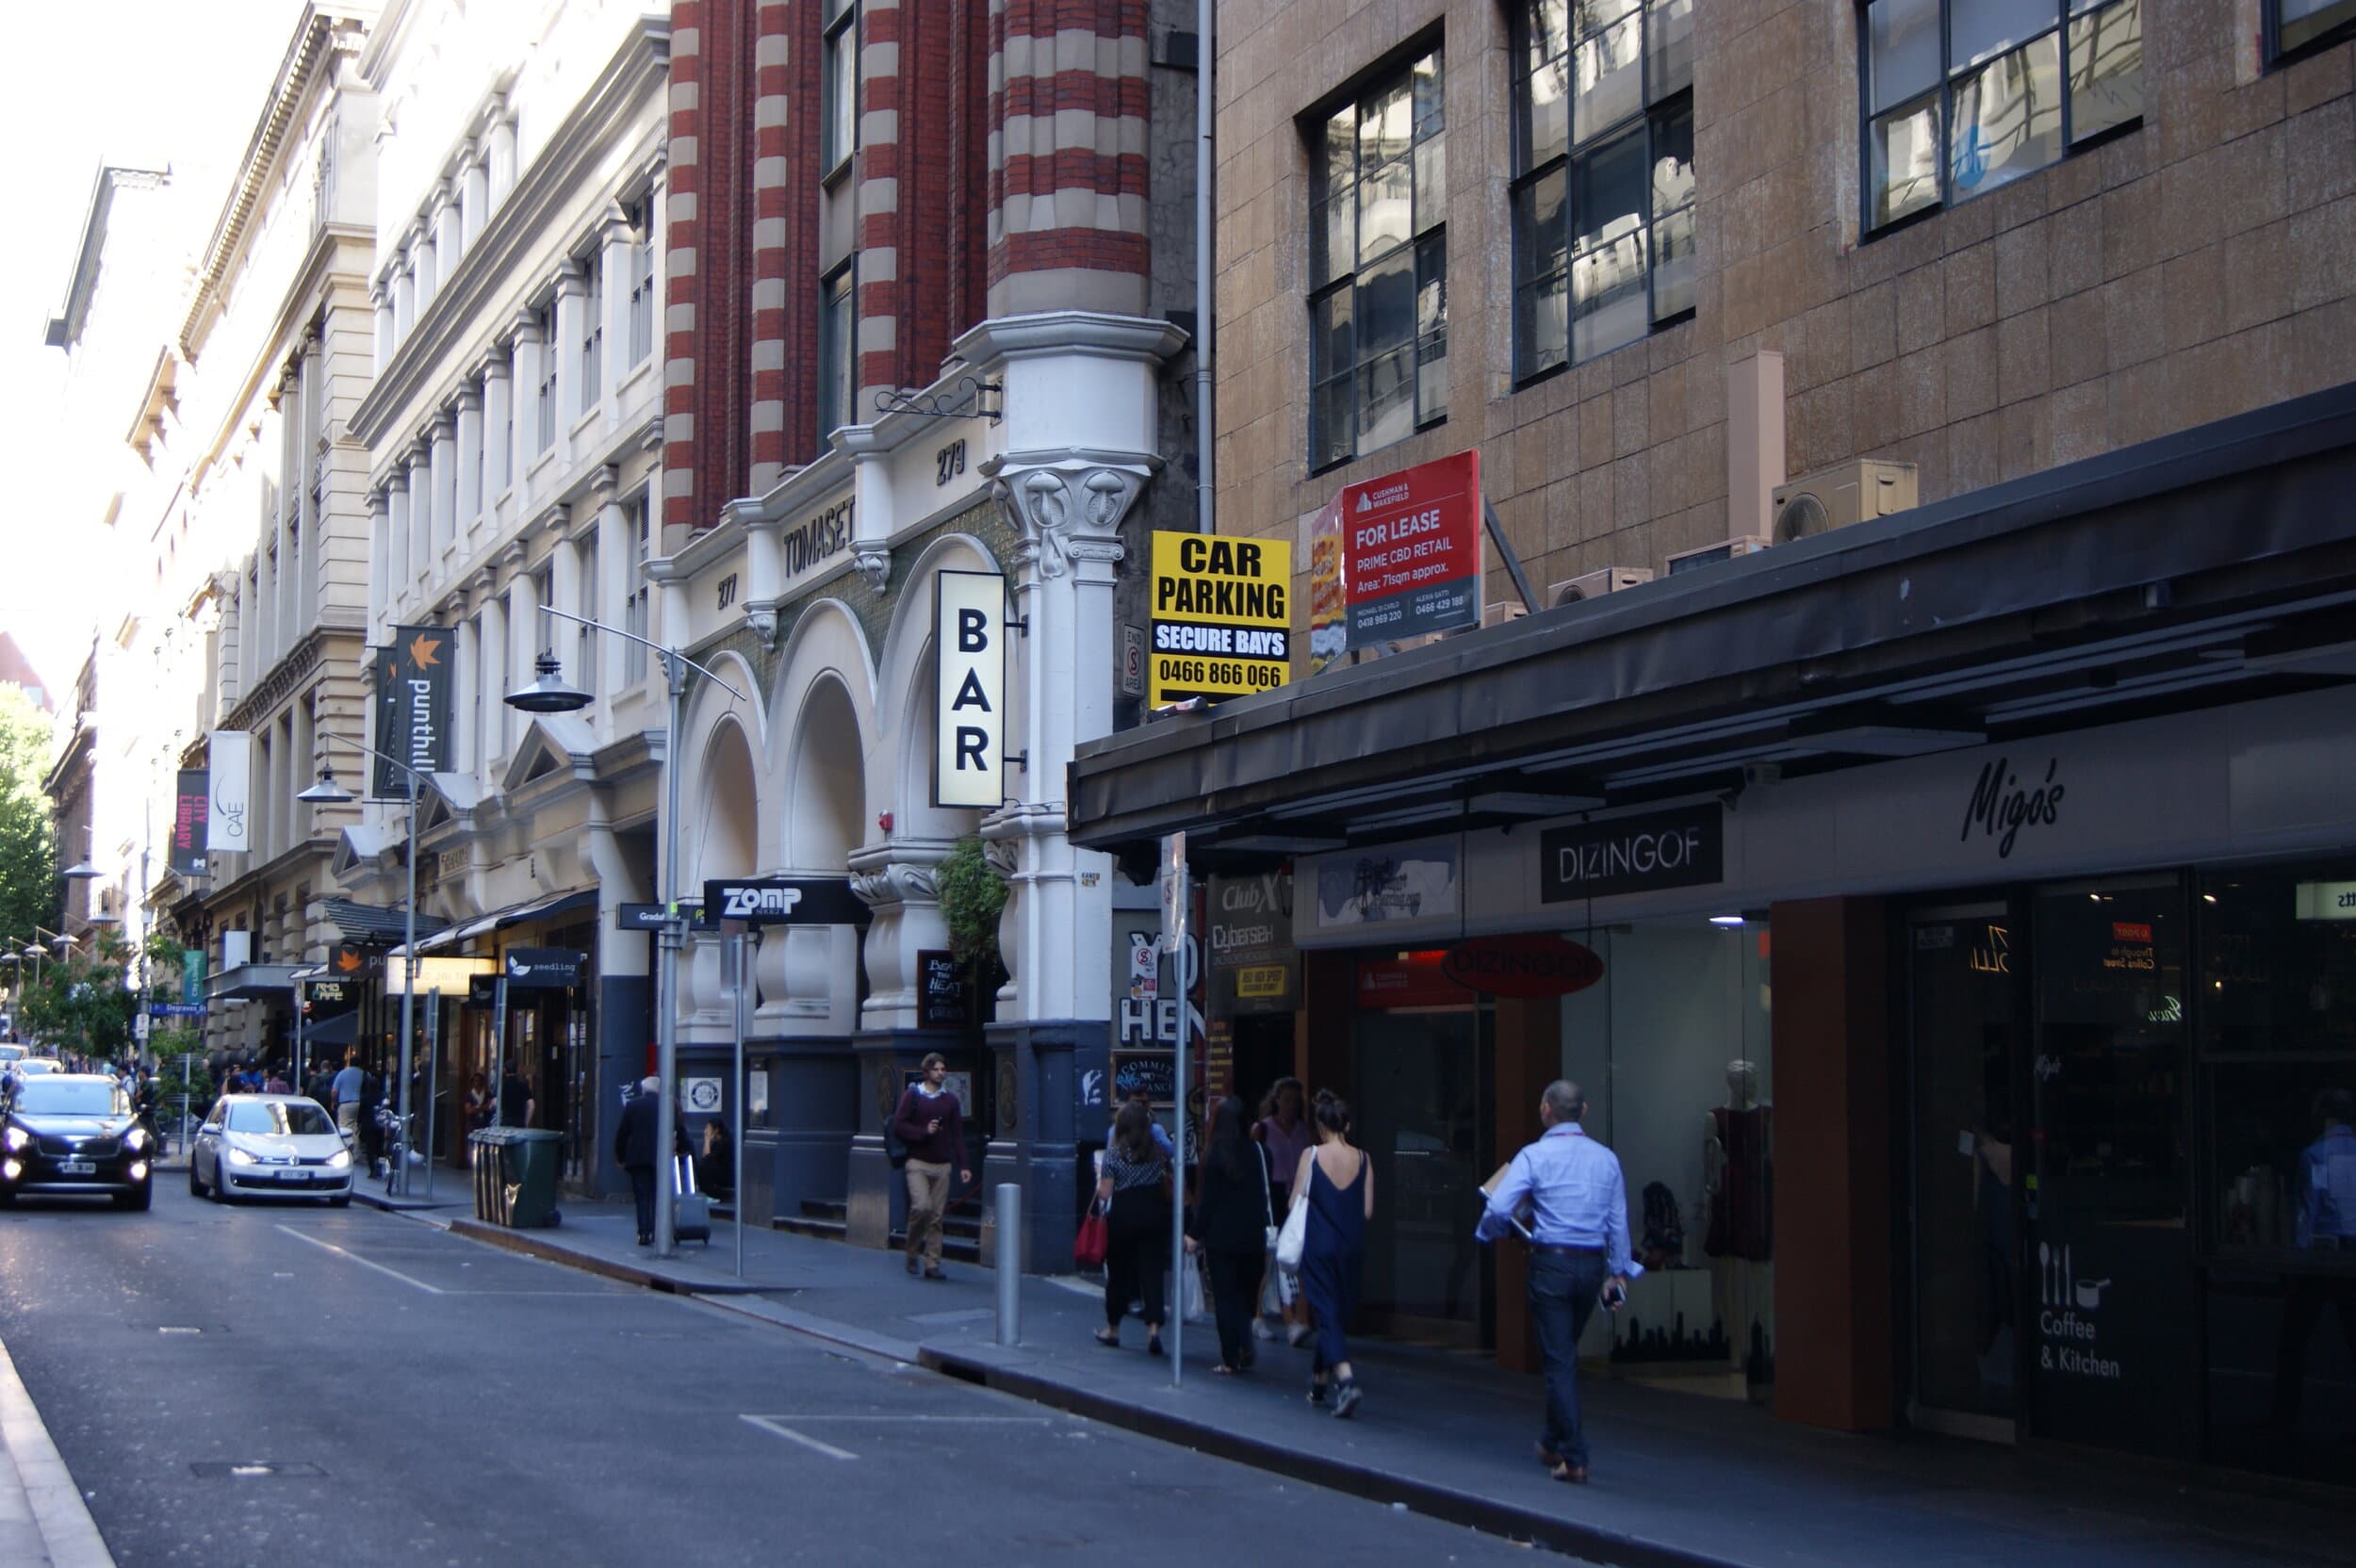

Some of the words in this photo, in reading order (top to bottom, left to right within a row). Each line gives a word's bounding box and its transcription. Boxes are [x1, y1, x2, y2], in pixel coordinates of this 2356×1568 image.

[937, 438, 966, 486] 279
[1372, 483, 1403, 499] CUSHMAN
[1404, 482, 1409, 491] &
[1373, 492, 1410, 508] WAKEFIELD
[783, 495, 856, 579] TOMASET
[1356, 524, 1387, 549] FOR
[1390, 509, 1441, 540] LEASE
[1181, 538, 1262, 578] CAR
[1357, 552, 1387, 573] PRIME
[1390, 547, 1412, 564] CBD
[1414, 536, 1453, 558] RETAIL
[718, 573, 737, 611] 277
[1357, 578, 1381, 594] Area:
[1383, 570, 1410, 588] 71sqm
[1412, 563, 1449, 581] approx.
[1158, 576, 1285, 619] PARKING
[1436, 598, 1450, 609] 429
[1357, 616, 1374, 629] 0418
[1389, 611, 1402, 621] 220
[1155, 625, 1232, 653] SECURE
[1235, 629, 1285, 656] BAYS
[951, 608, 992, 771] BAR
[1160, 660, 1204, 683] 0466
[1209, 662, 1243, 685] 866
[1248, 665, 1281, 687] 066
[407, 679, 436, 773] punthill
[175, 794, 192, 849] LIBRARY
[194, 795, 207, 823] CITY
[228, 802, 243, 837] CAE
[1961, 757, 2064, 858] Migo's
[1560, 826, 1699, 883] DIZINGOF
[724, 888, 802, 915] ZOMP
[534, 962, 576, 972] seedling
[167, 1004, 197, 1013] Degraves
[2040, 1310, 2096, 1340] Coffee
[2040, 1345, 2053, 1369] &
[2059, 1346, 2120, 1380] Kitchen
